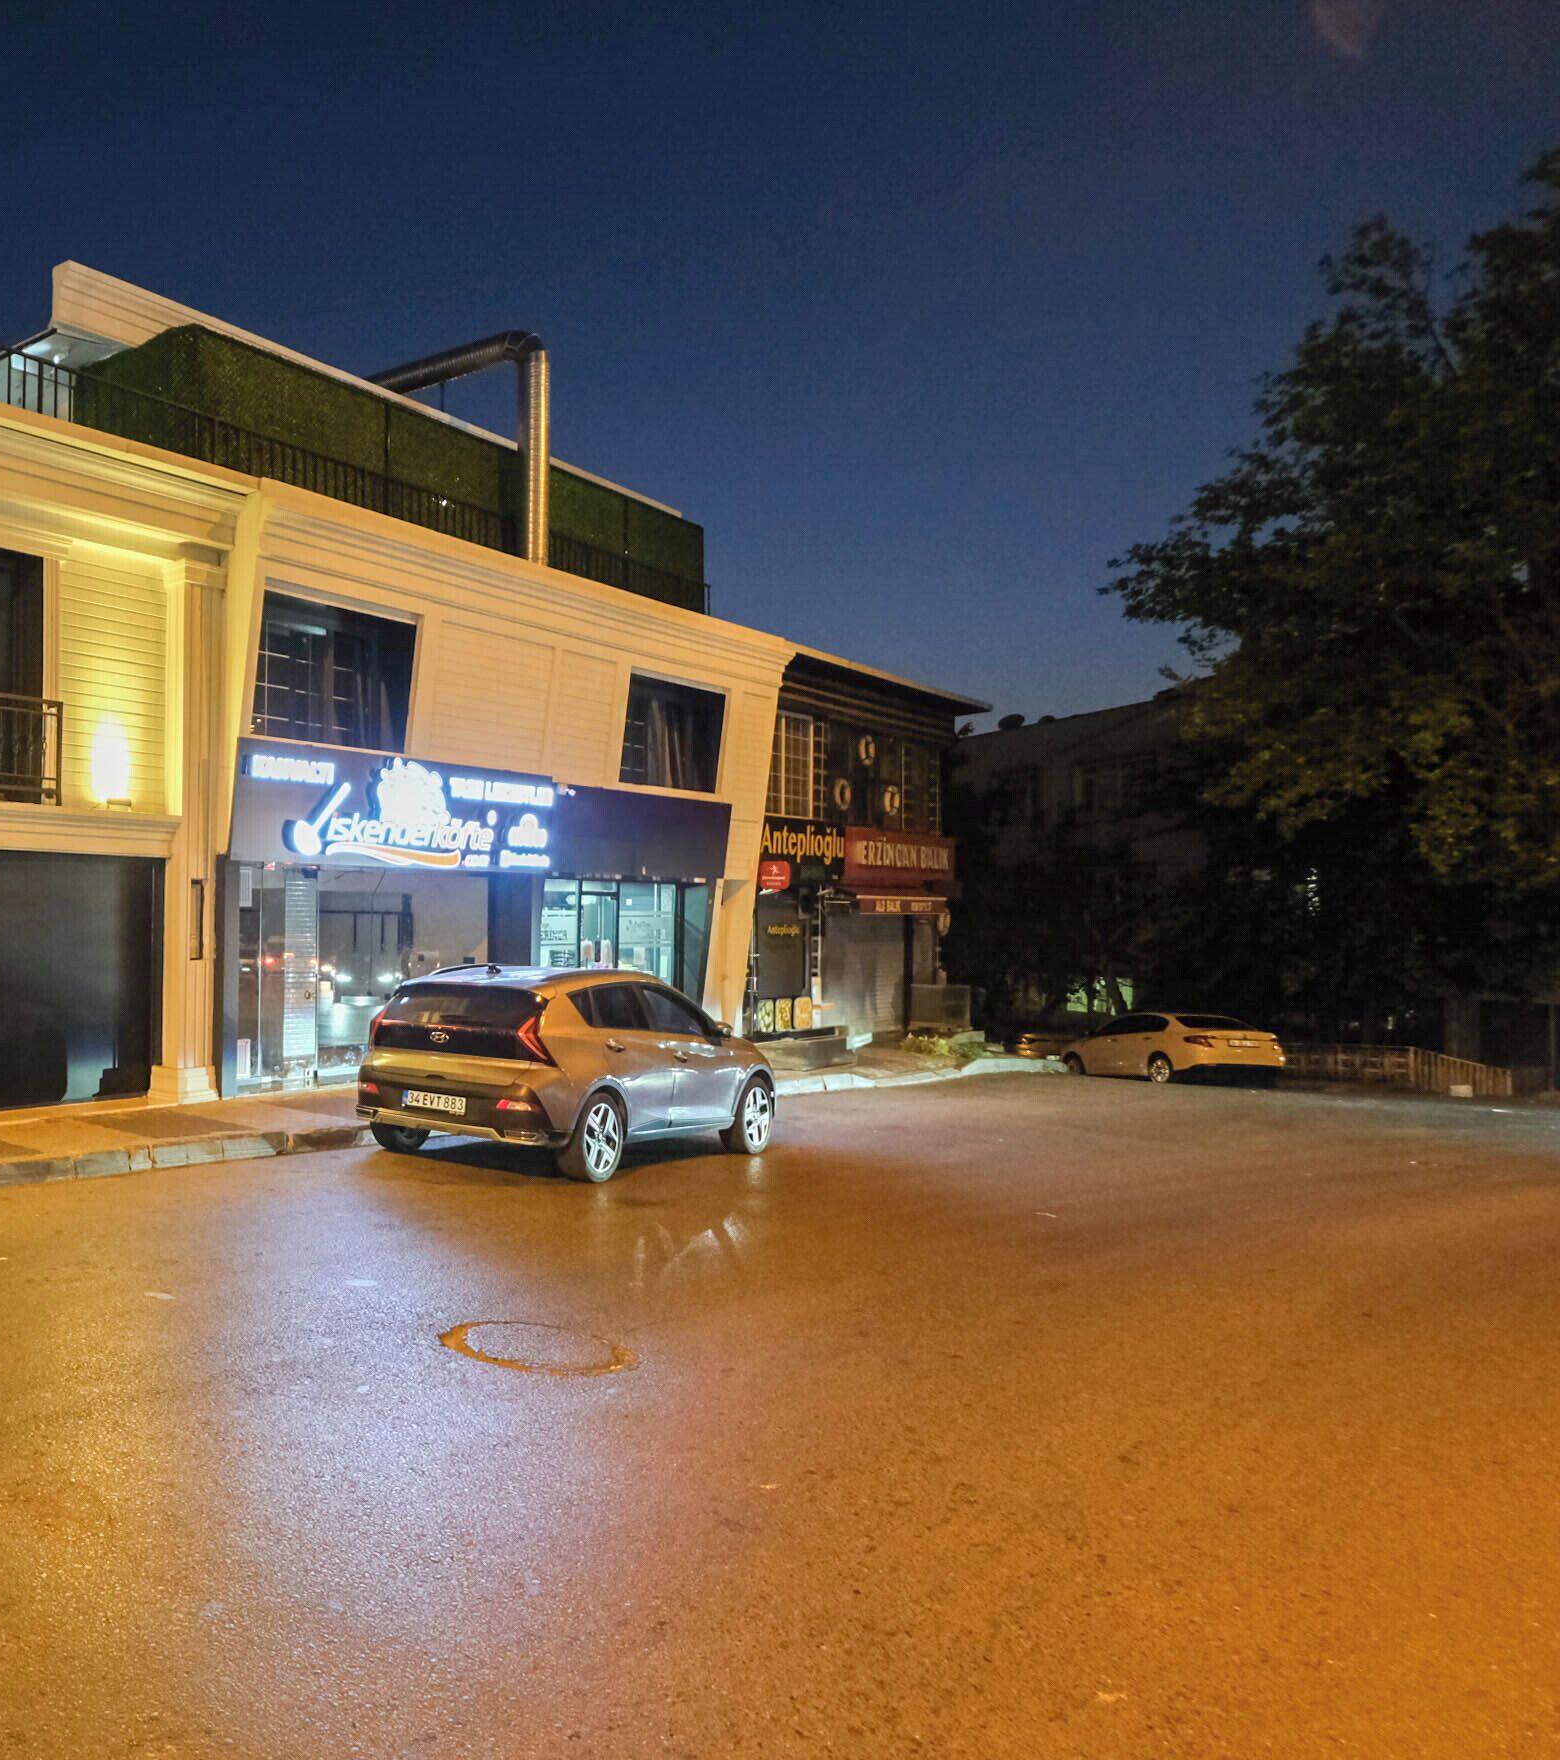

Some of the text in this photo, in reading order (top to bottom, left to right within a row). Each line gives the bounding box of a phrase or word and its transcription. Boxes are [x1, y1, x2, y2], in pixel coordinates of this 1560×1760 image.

[760, 823, 845, 865] Anteplioğlu
[408, 1092, 464, 1110] 34 EVT 883
